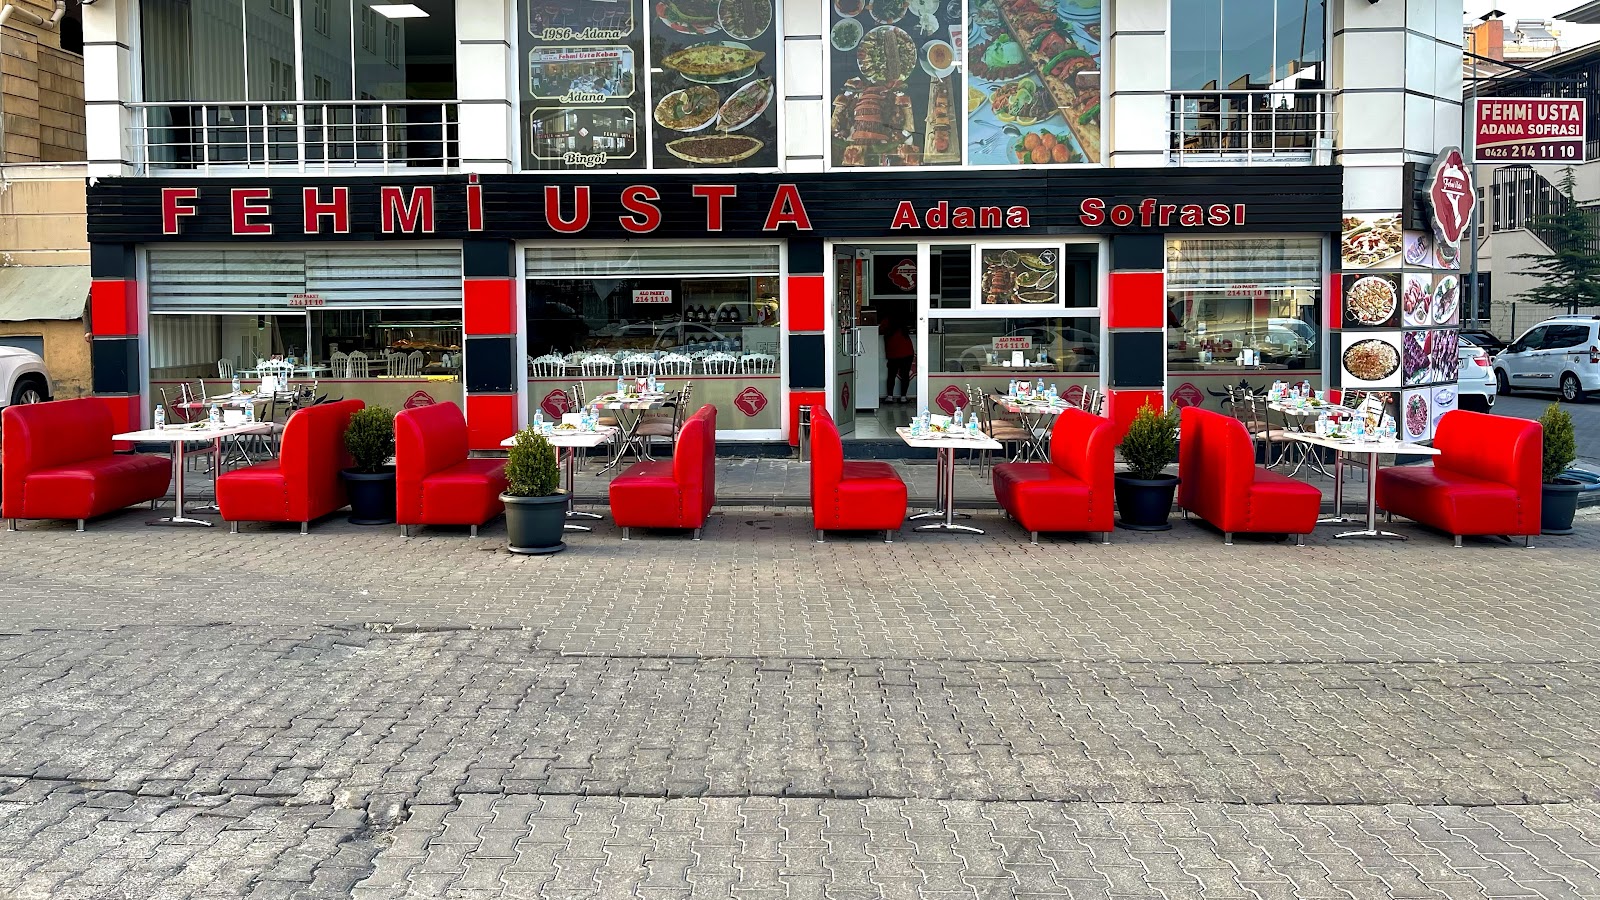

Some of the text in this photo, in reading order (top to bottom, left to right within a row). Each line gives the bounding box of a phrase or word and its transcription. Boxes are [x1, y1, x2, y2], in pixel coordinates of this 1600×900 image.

[542, 27, 620, 39] 1986 Adana
[560, 92, 605, 102] Adana
[1537, 104, 1580, 121] USTA
[1480, 123, 1580, 135] ADANA SOFRASI
[1484, 145, 1575, 158] 0426 214 11 10
[564, 153, 606, 166] Bingöl
[543, 184, 814, 235] USTA
[889, 200, 1031, 230] Adana
[1079, 197, 1246, 228] Sofrası
